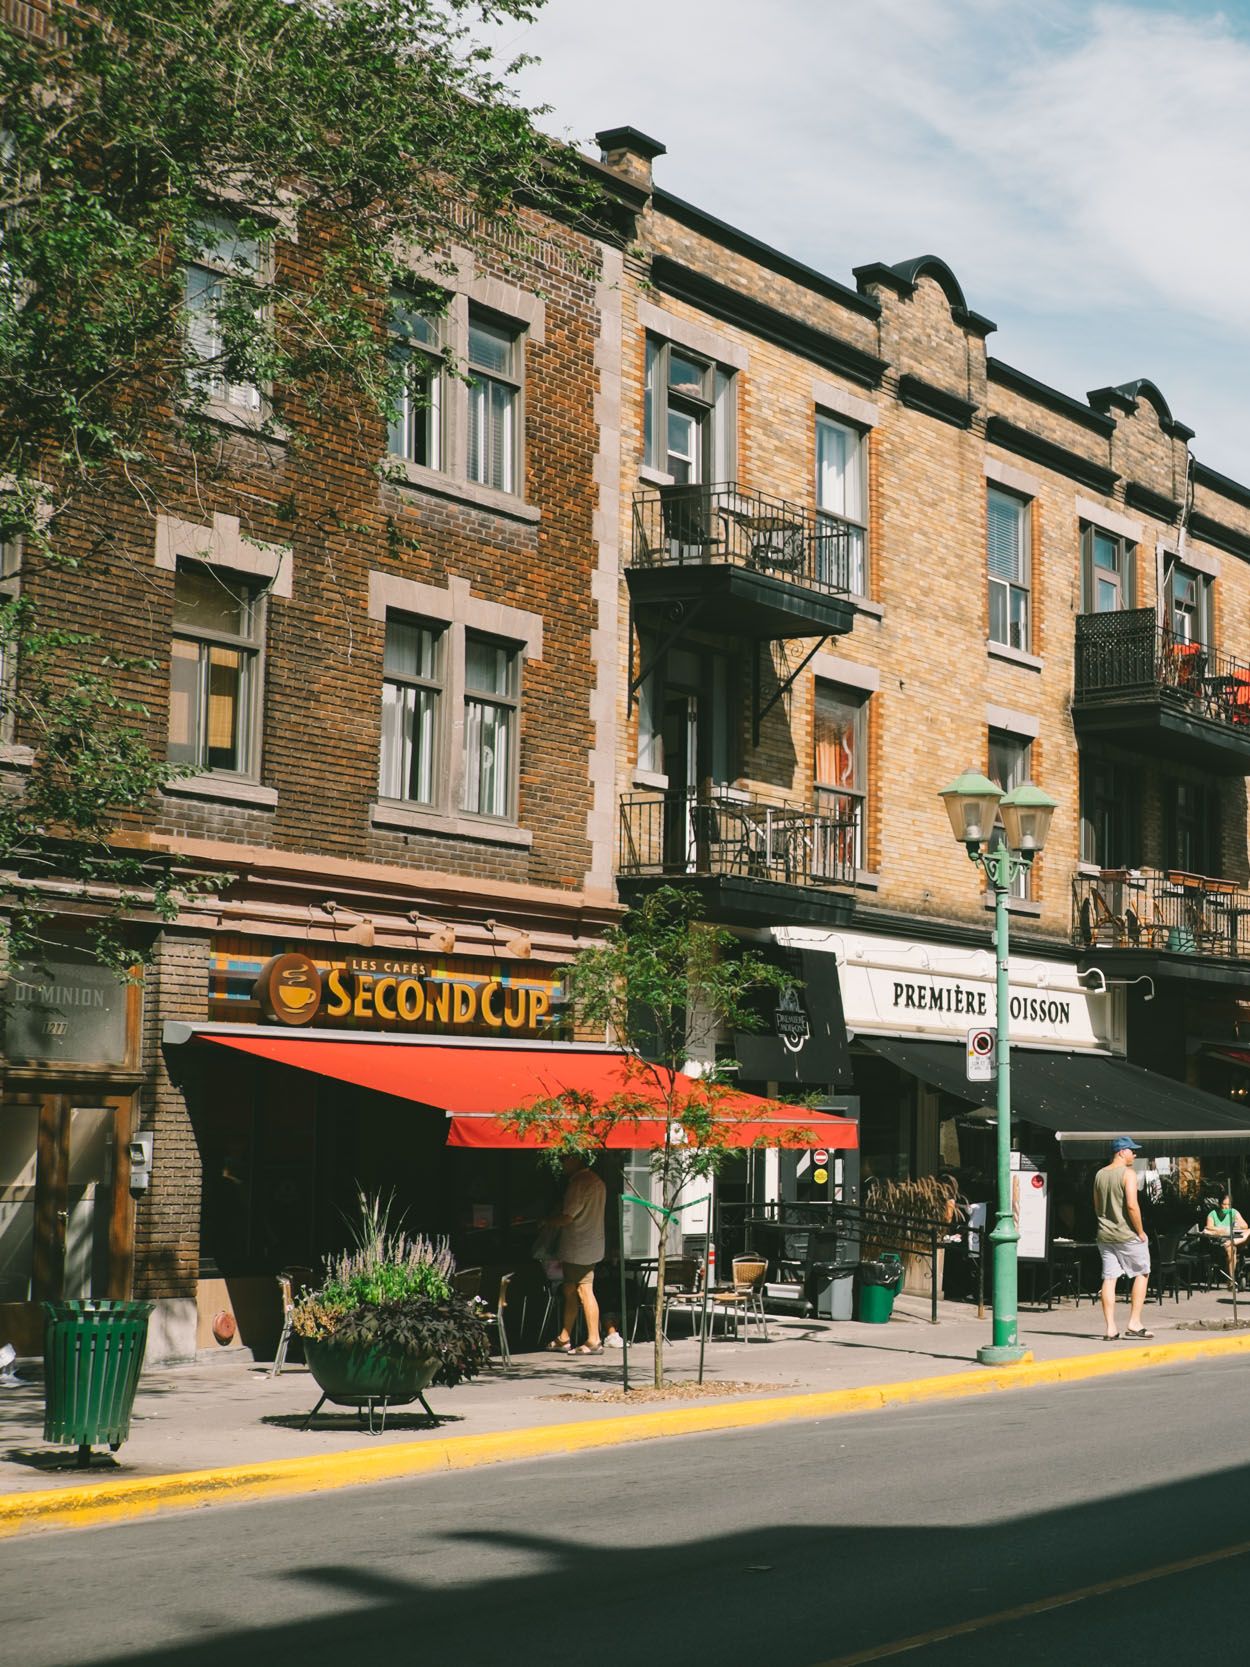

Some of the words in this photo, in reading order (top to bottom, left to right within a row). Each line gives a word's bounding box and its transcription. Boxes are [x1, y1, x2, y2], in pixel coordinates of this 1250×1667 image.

[352, 959, 377, 971] LES
[384, 962, 426, 975] CAFÉS
[327, 968, 477, 1024] SECOND
[481, 981, 549, 1029] CUP
[893, 982, 987, 1016] PREMIÈRE
[995, 993, 1070, 1024] OISSON
[42, 1022, 67, 1034] 1277
